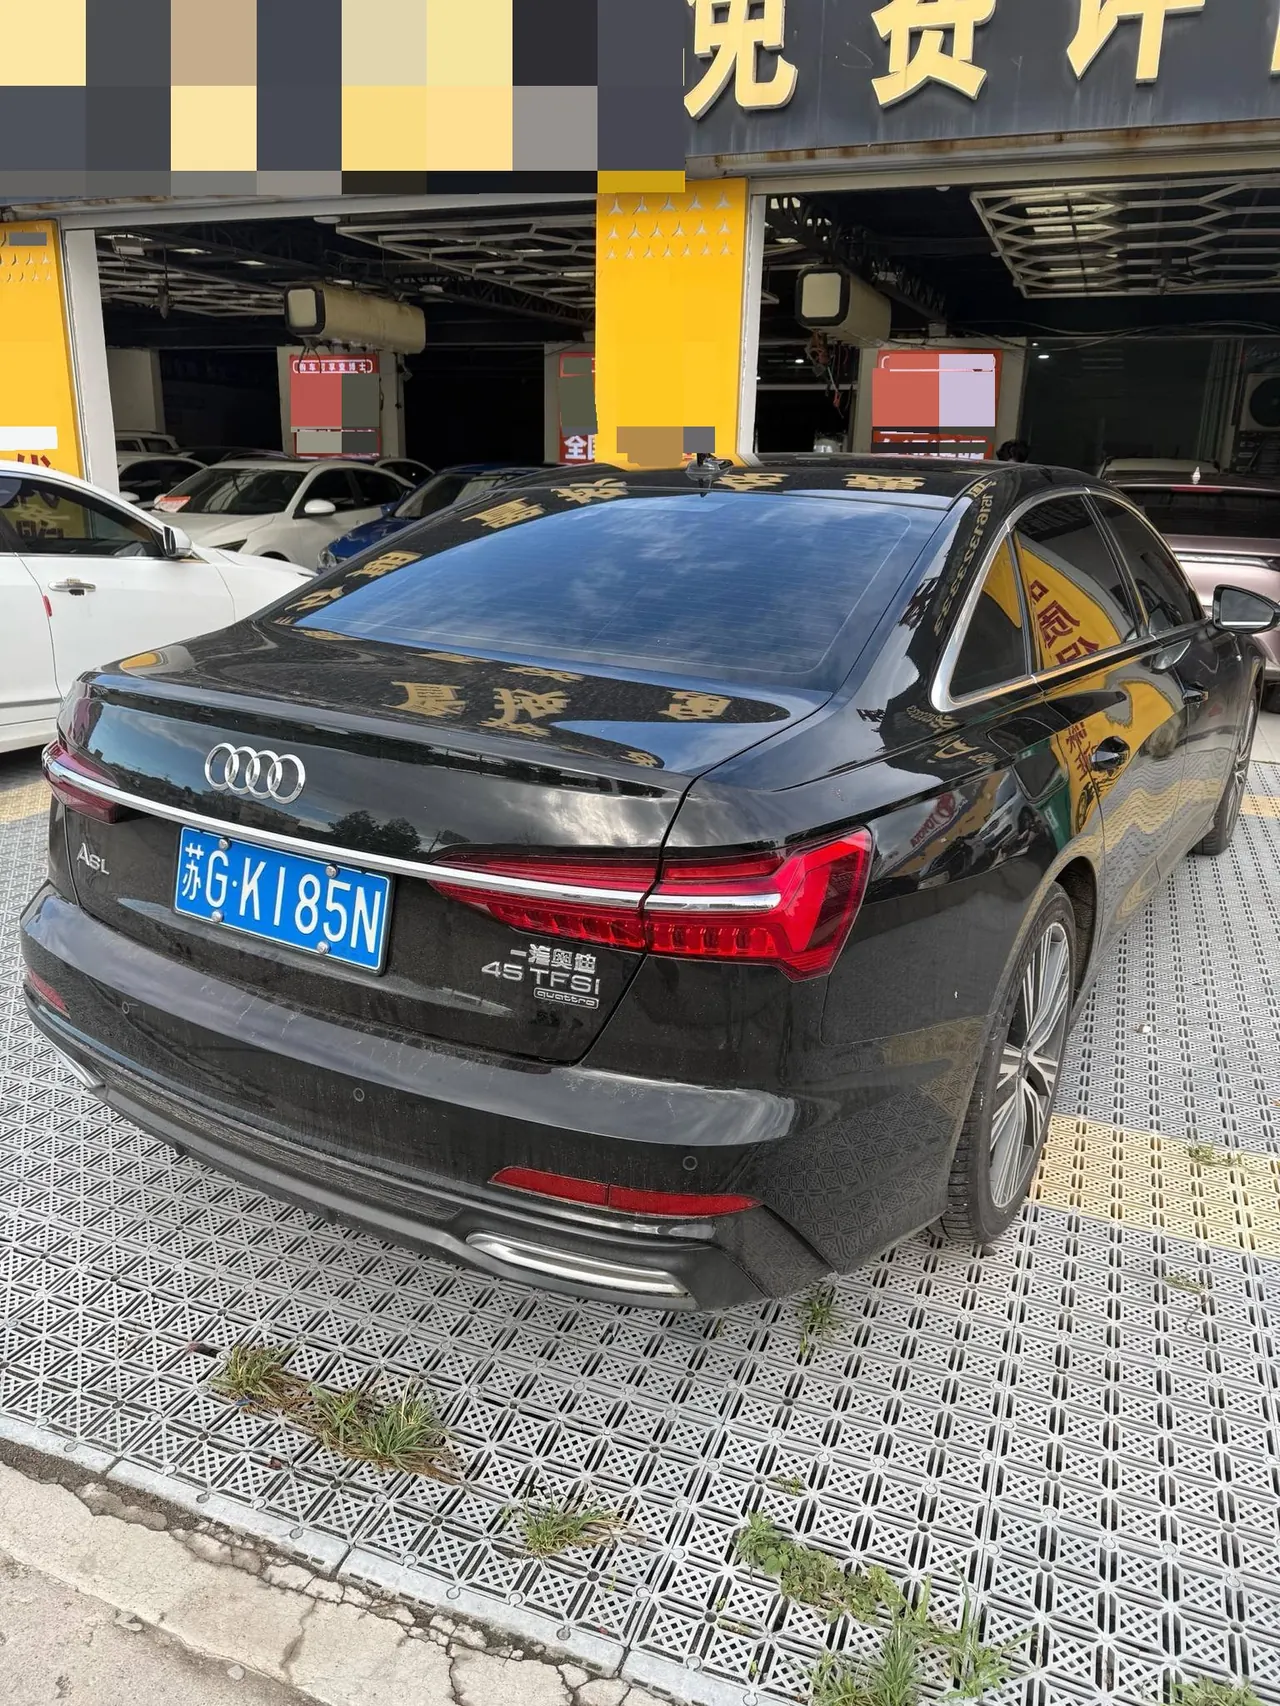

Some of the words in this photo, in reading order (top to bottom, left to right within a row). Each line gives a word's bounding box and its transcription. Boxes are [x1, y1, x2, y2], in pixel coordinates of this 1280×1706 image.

[510, 944, 597, 975] 一汽奥迪
[481, 961, 524, 981] 45
[529, 967, 600, 995] TFSI
[536, 990, 596, 1007] quattro
